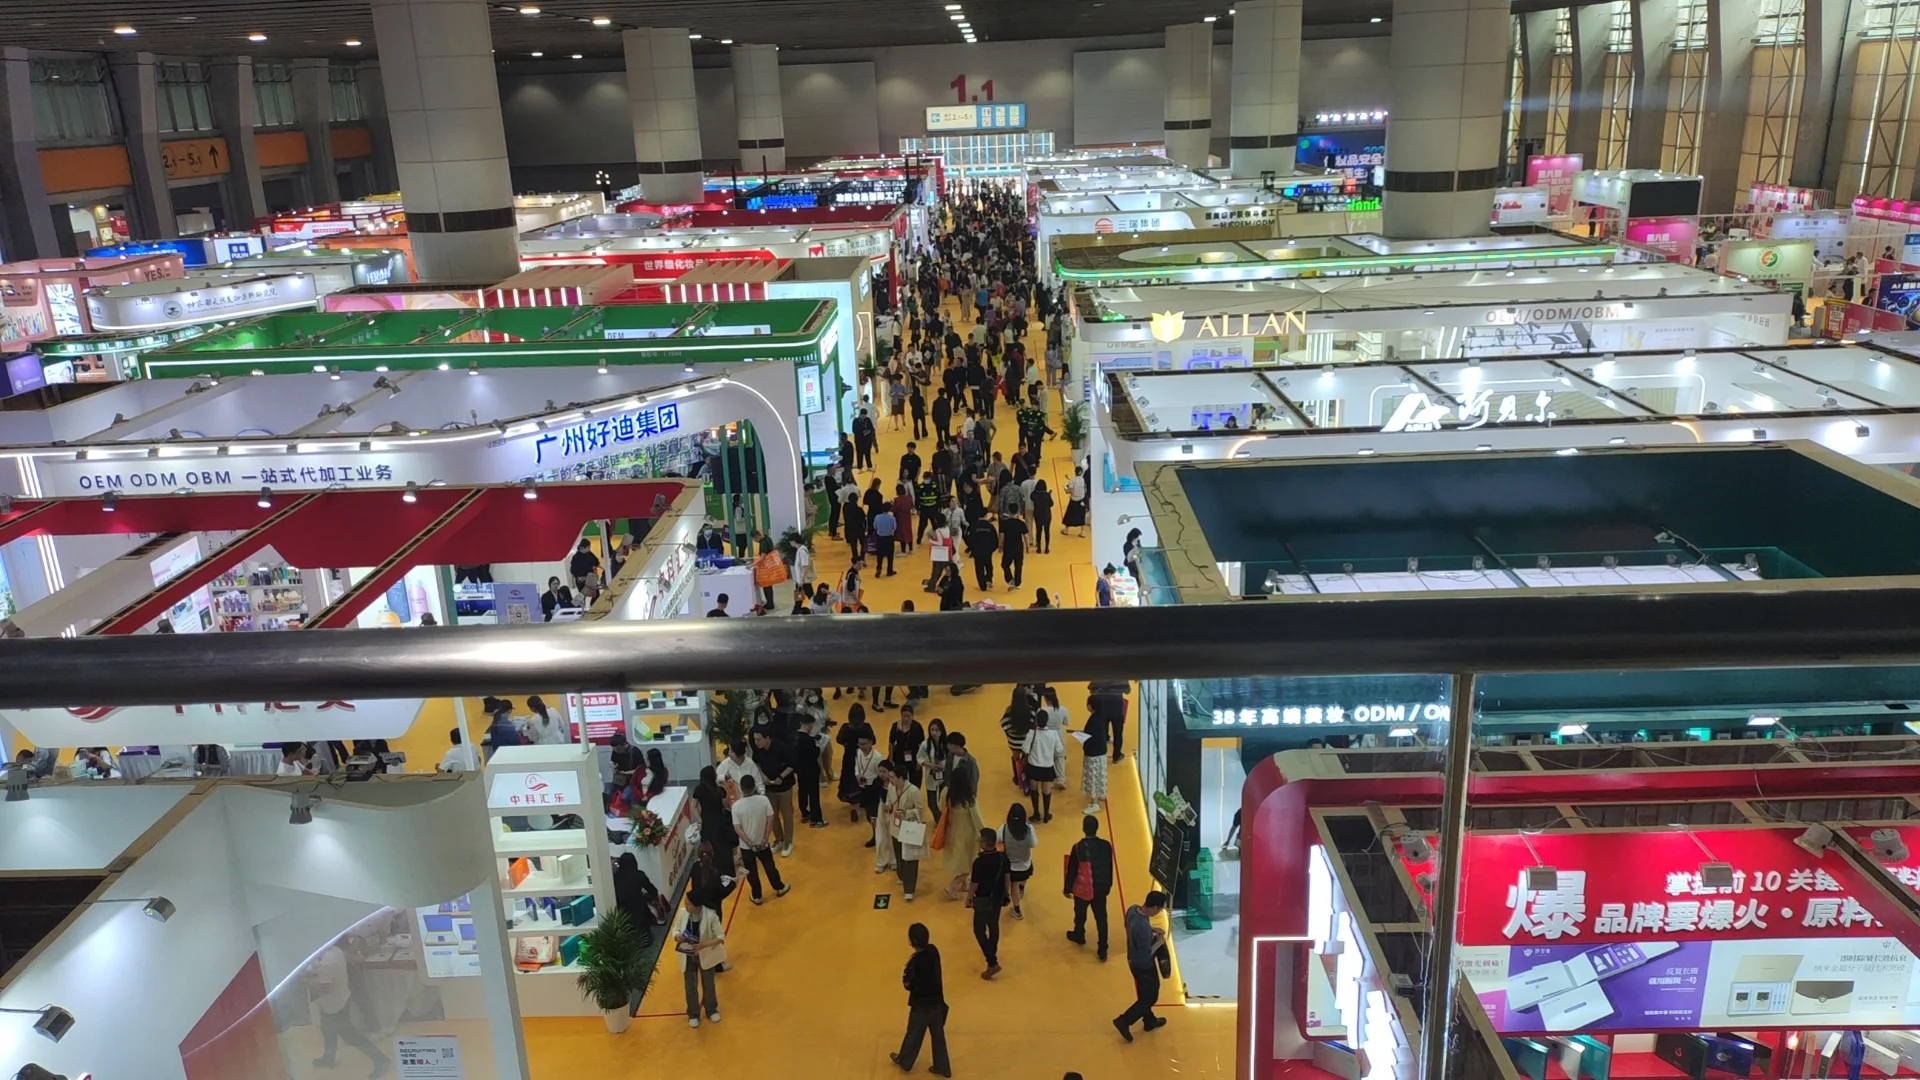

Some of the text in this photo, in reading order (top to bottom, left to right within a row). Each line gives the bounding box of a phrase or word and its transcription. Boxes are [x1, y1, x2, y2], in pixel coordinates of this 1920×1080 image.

[950, 75, 993, 103] 1.1
[1196, 310, 1306, 338] ALLAN
[1485, 305, 1620, 324] OEM/ODM/OBM
[534, 402, 680, 465] 广州好迪集团
[79, 464, 393, 490] OEM ODM OBM 一站式代加工业务
[1212, 705, 1345, 726] 38年高端美妆
[510, 793, 564, 805] 中科汇乐
[1750, 871, 1782, 891] 10
[1502, 870, 1586, 939] 爆
